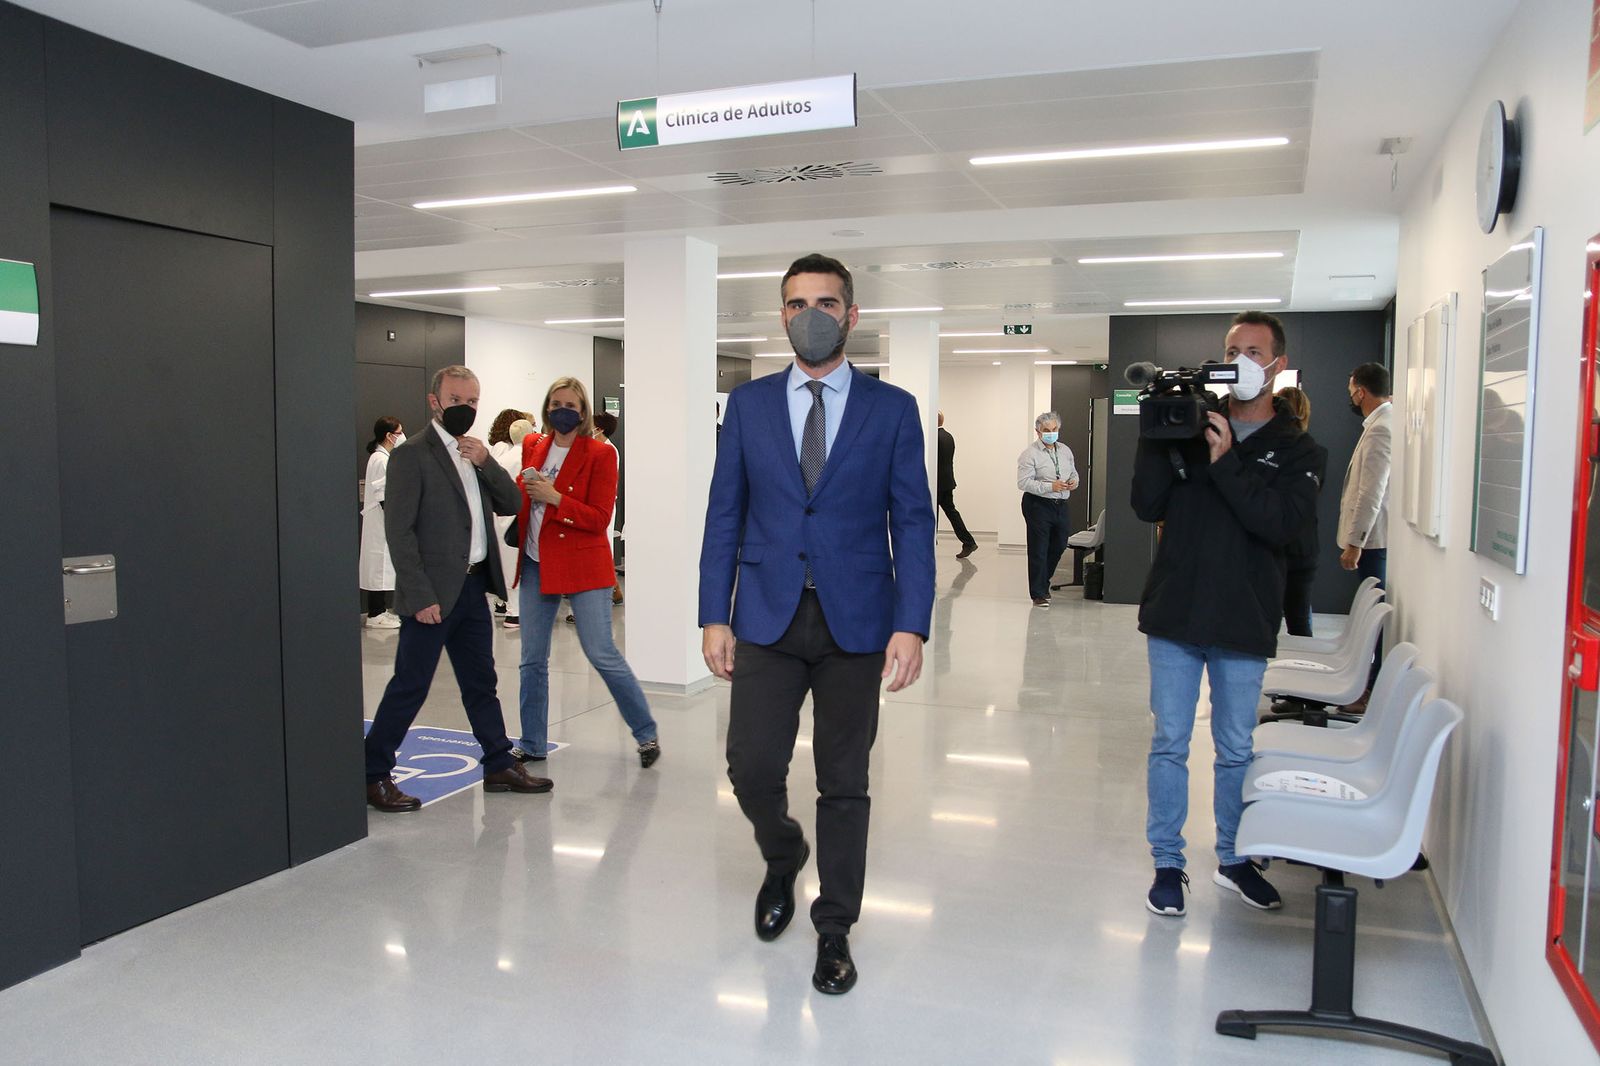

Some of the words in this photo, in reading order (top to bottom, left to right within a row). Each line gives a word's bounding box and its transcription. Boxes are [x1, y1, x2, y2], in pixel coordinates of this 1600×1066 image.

[723, 106, 743, 121] de
[747, 100, 812, 119] Adultos
[416, 735, 478, 747] Reservado
